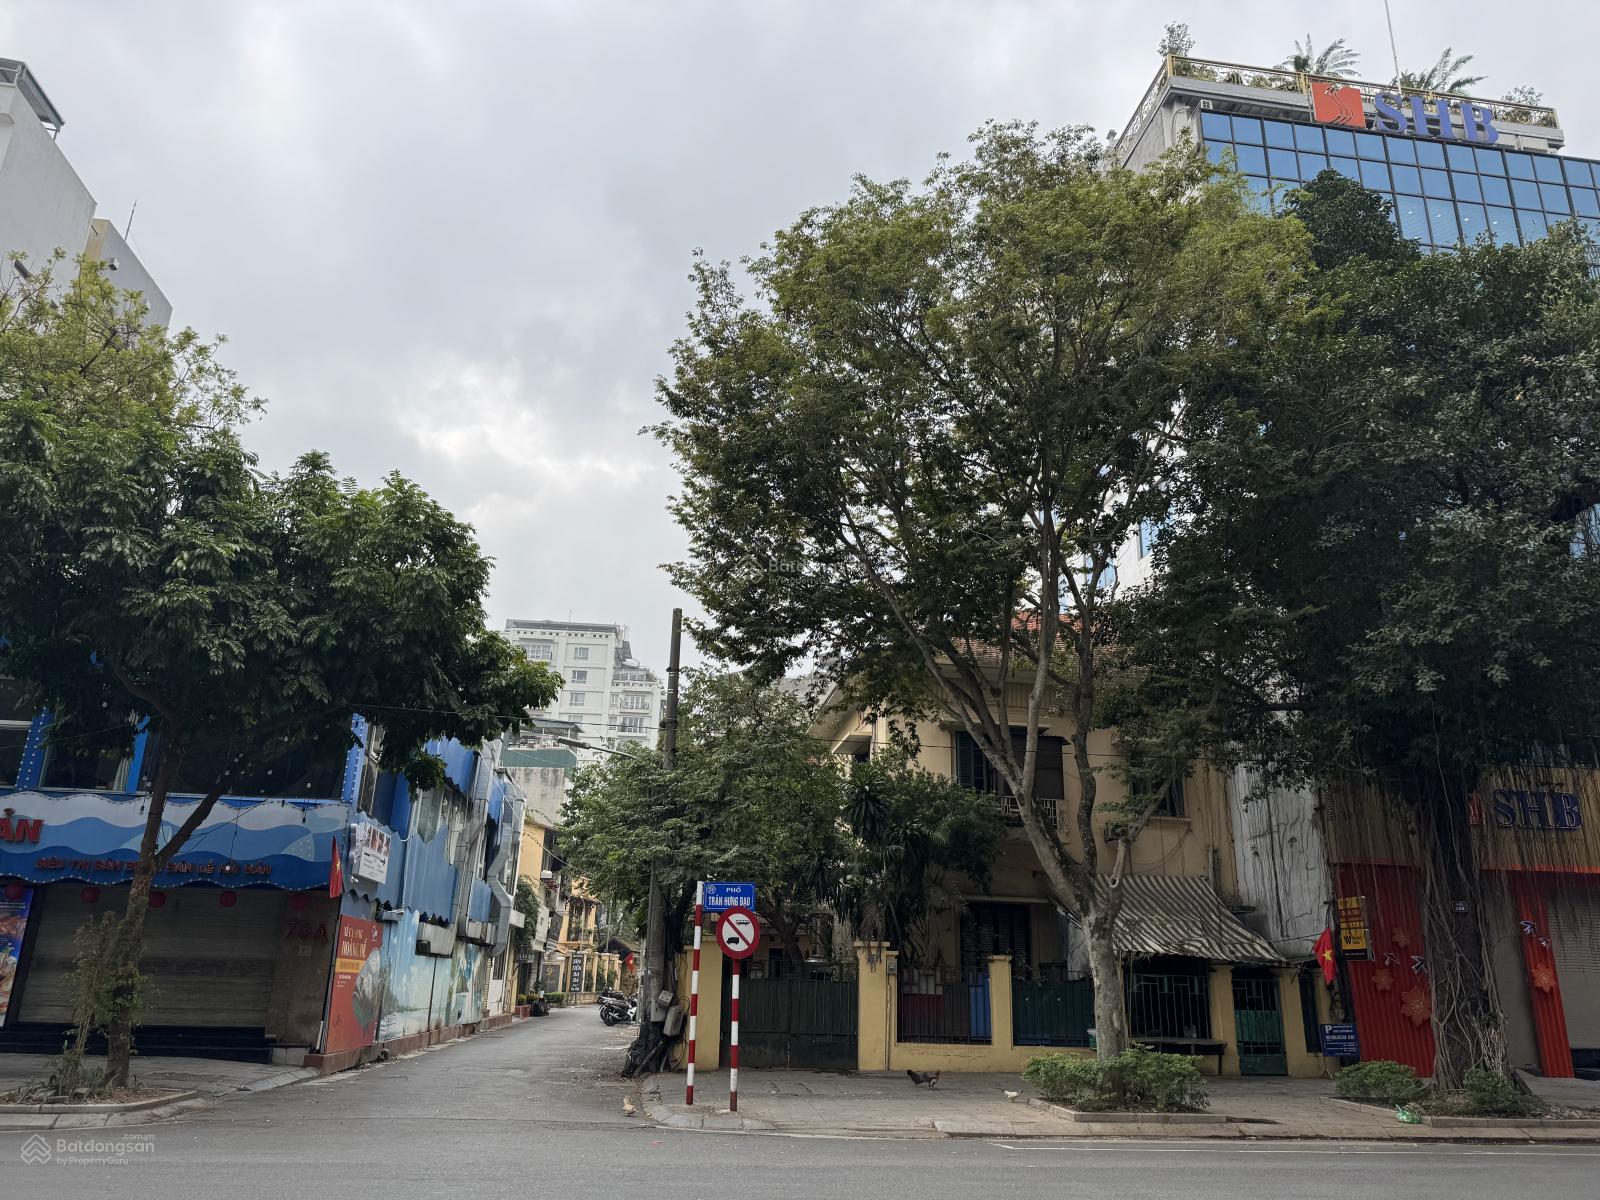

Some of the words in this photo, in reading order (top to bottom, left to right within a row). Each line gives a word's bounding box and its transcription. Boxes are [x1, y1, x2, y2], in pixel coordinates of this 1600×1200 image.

[1375, 91, 1498, 144] SHB
[1493, 789, 1583, 829] SHB
[708, 894, 723, 906] TRẦN
[723, 896, 739, 906] HƯNG
[739, 896, 751, 907] ĐẠO
[1324, 1024, 1333, 1034] P
